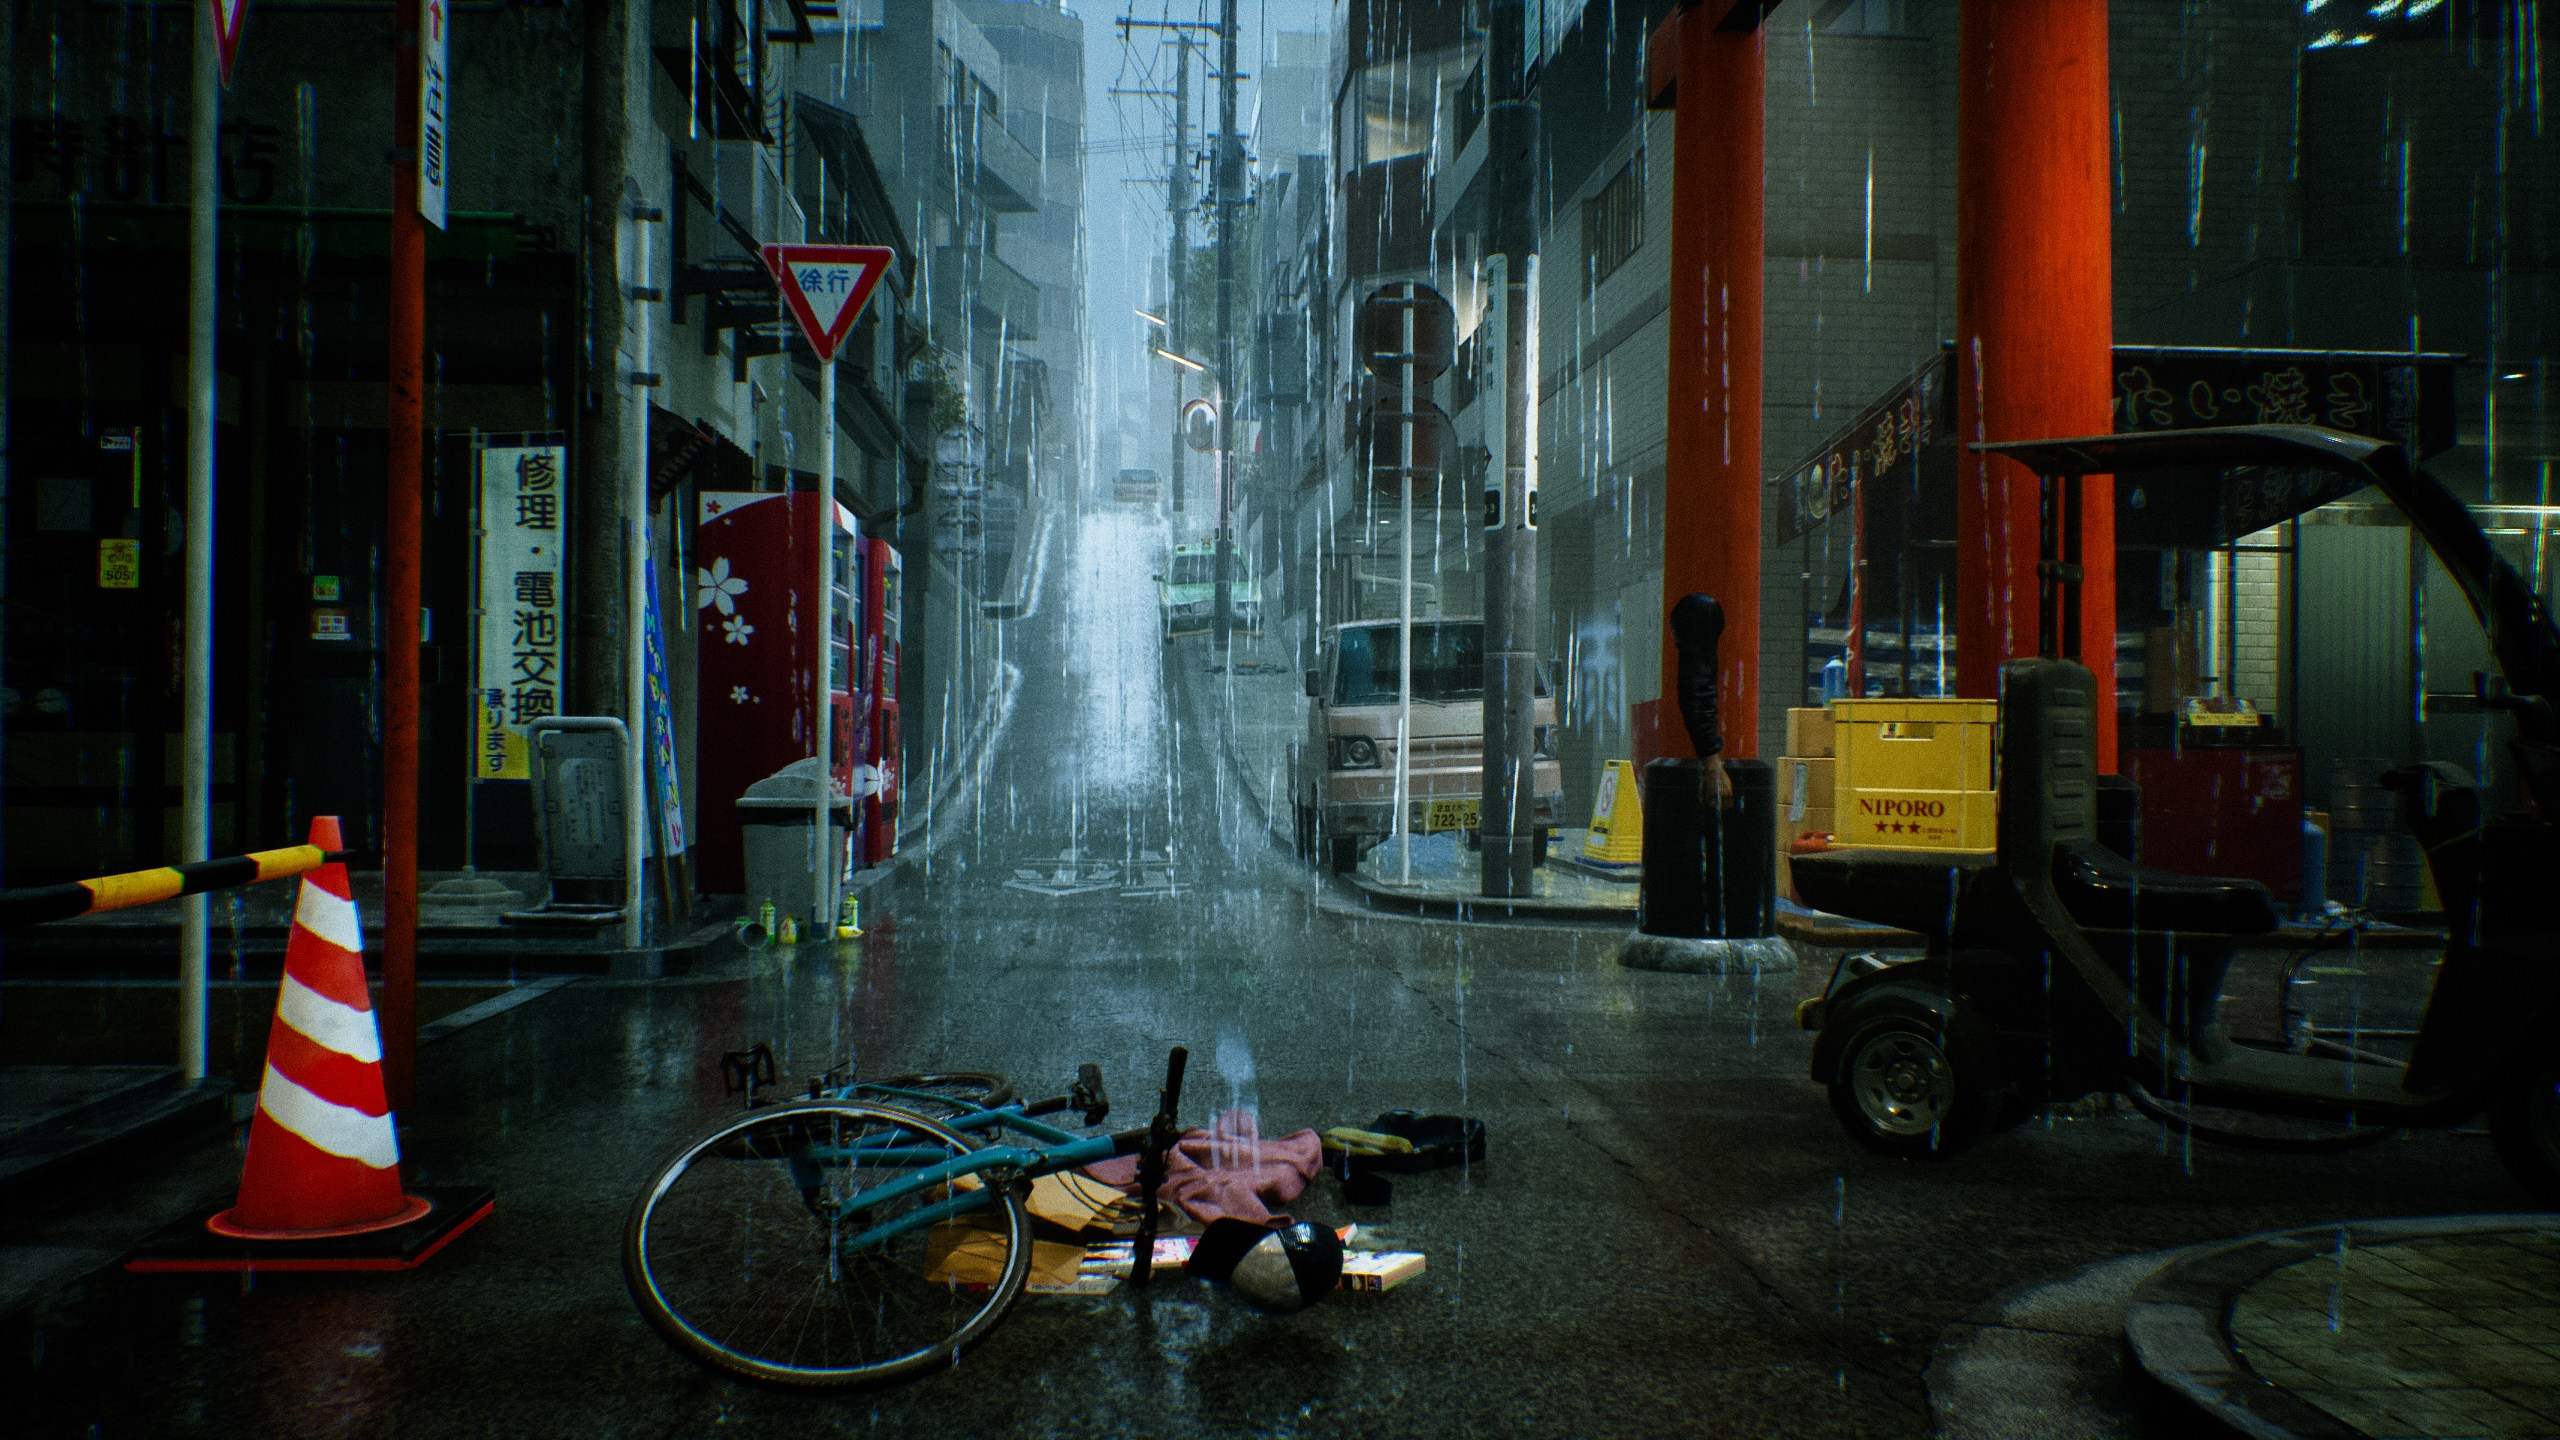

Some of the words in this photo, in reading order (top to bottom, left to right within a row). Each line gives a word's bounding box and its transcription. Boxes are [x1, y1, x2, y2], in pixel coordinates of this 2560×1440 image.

[799, 267, 849, 293] 徐行
[510, 453, 557, 726] 修理・電池交換
[485, 688, 506, 773] 承ります
[1859, 798, 1945, 818] NIPORO
